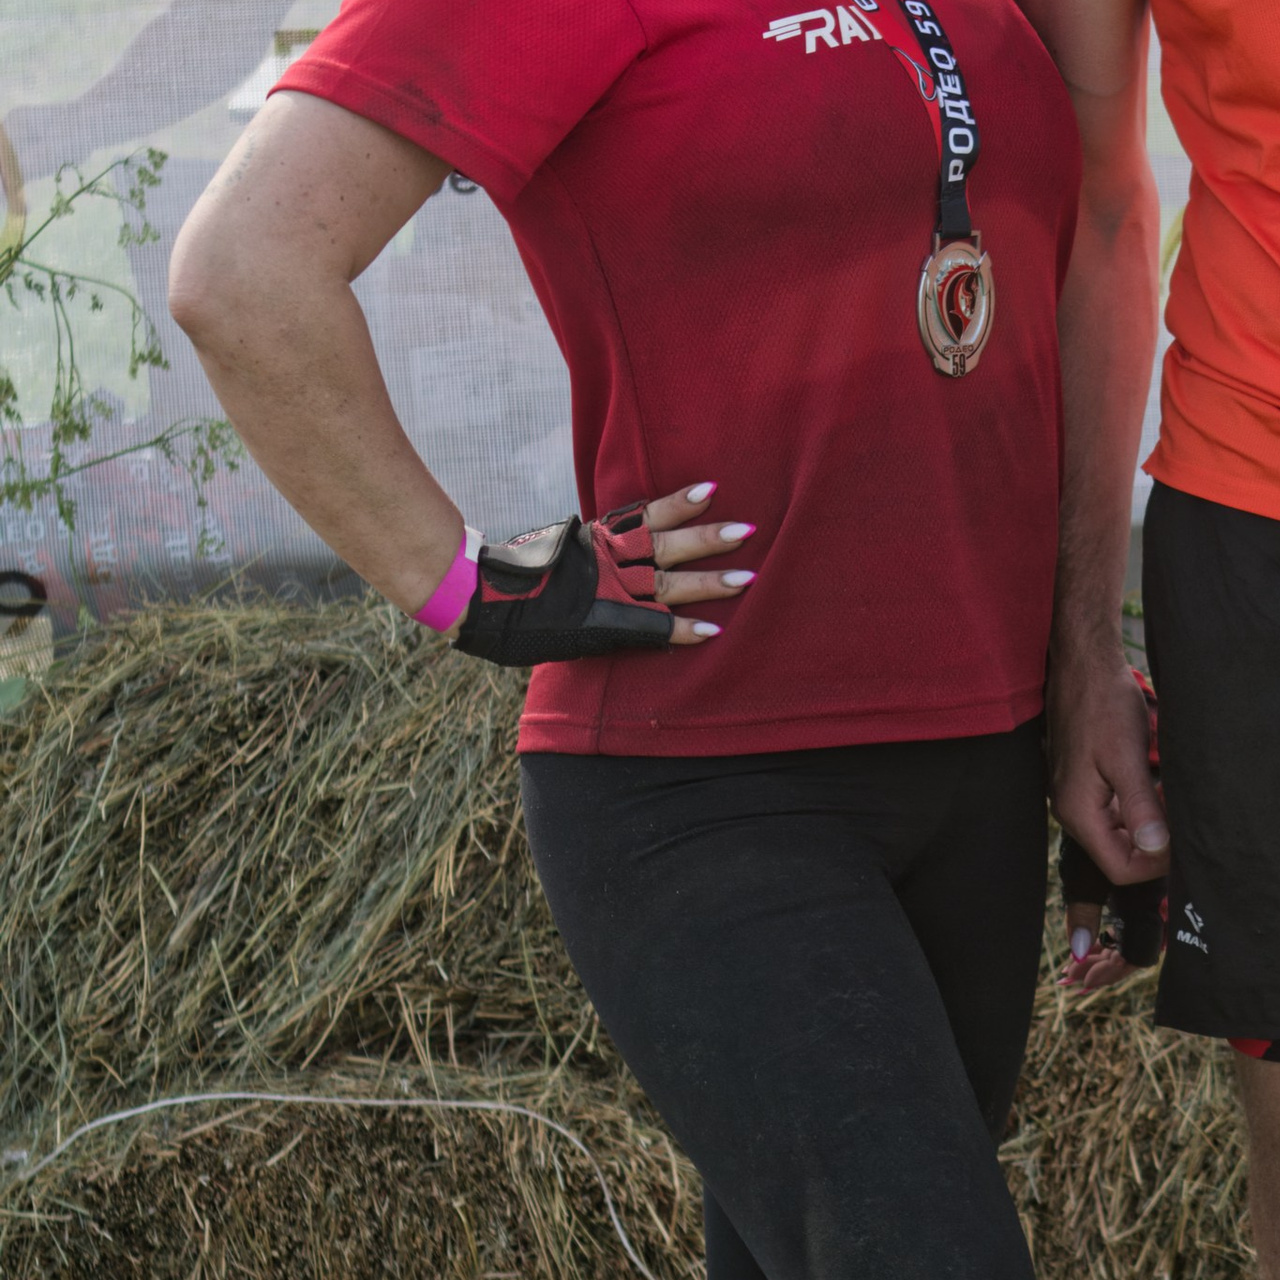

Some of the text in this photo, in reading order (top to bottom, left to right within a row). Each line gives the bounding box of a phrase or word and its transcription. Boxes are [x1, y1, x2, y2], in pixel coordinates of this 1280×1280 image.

[904, 0, 976, 182] РОДЕО 59
[943, 344, 974, 354] РОДЕО
[952, 354, 966, 376] 59
